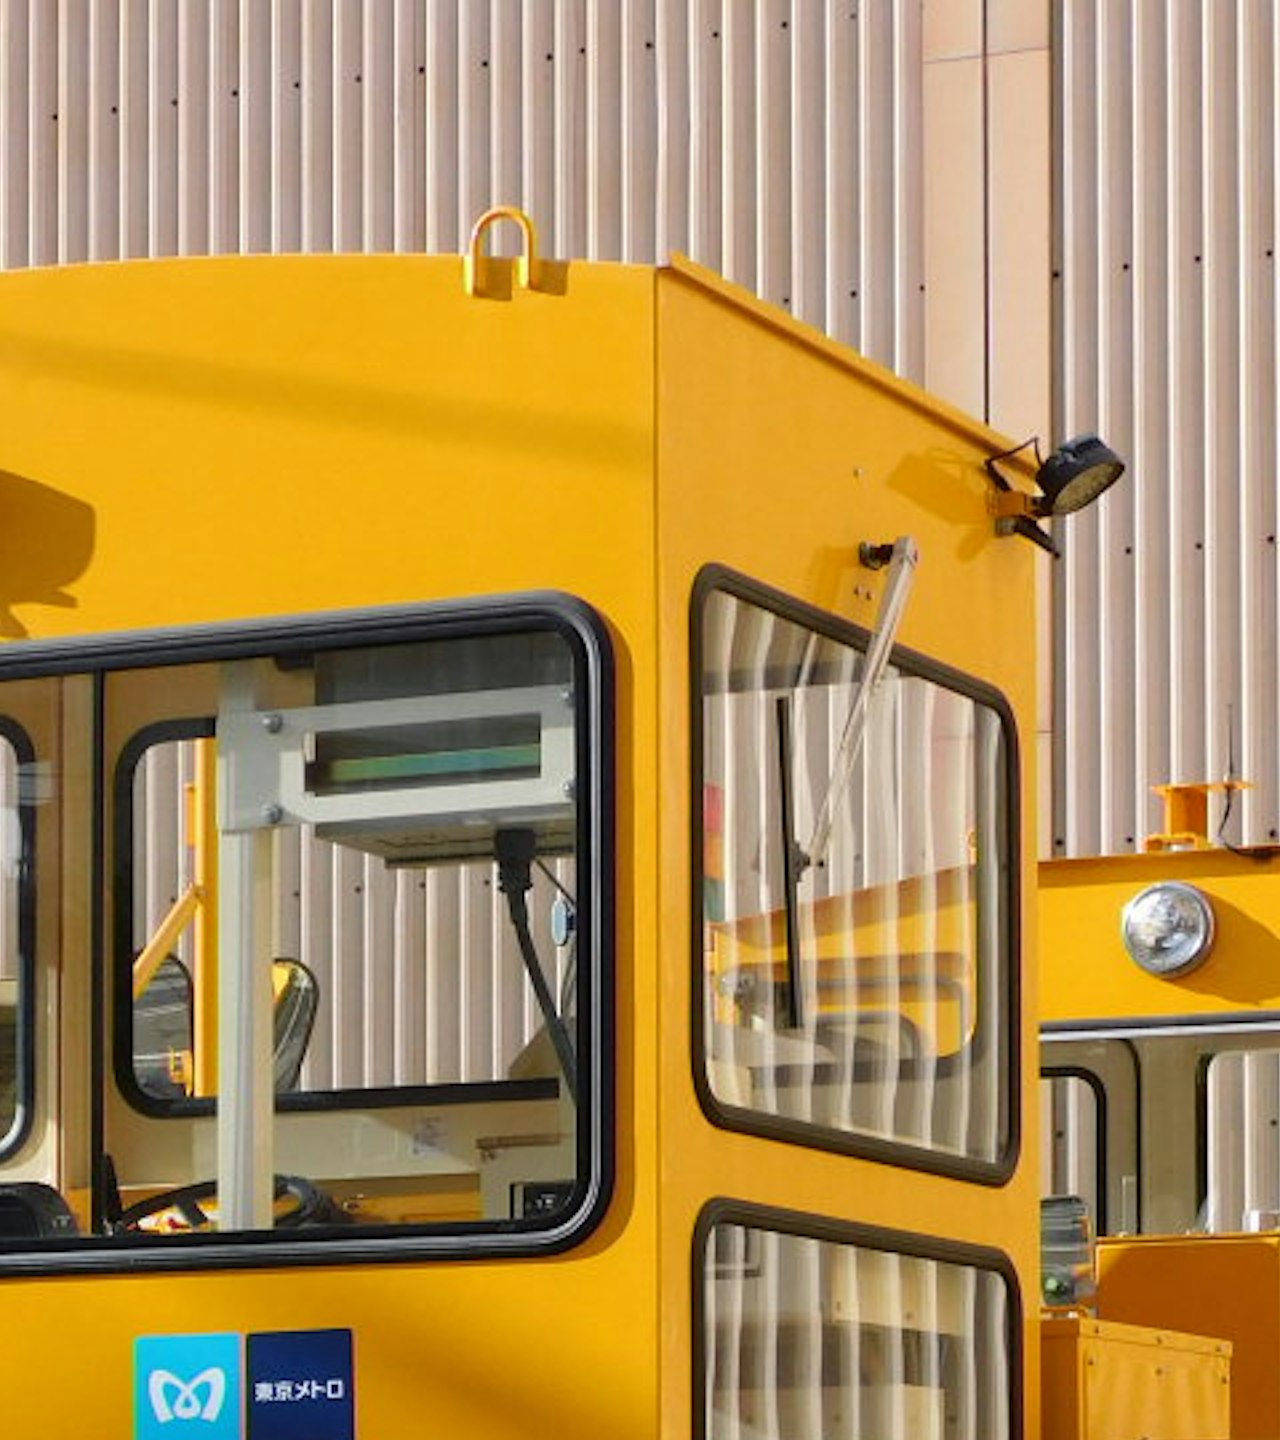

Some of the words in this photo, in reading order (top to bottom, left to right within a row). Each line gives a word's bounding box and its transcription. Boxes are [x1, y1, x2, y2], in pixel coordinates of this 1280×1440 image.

[254, 1378, 344, 1402] 東京メトロ
